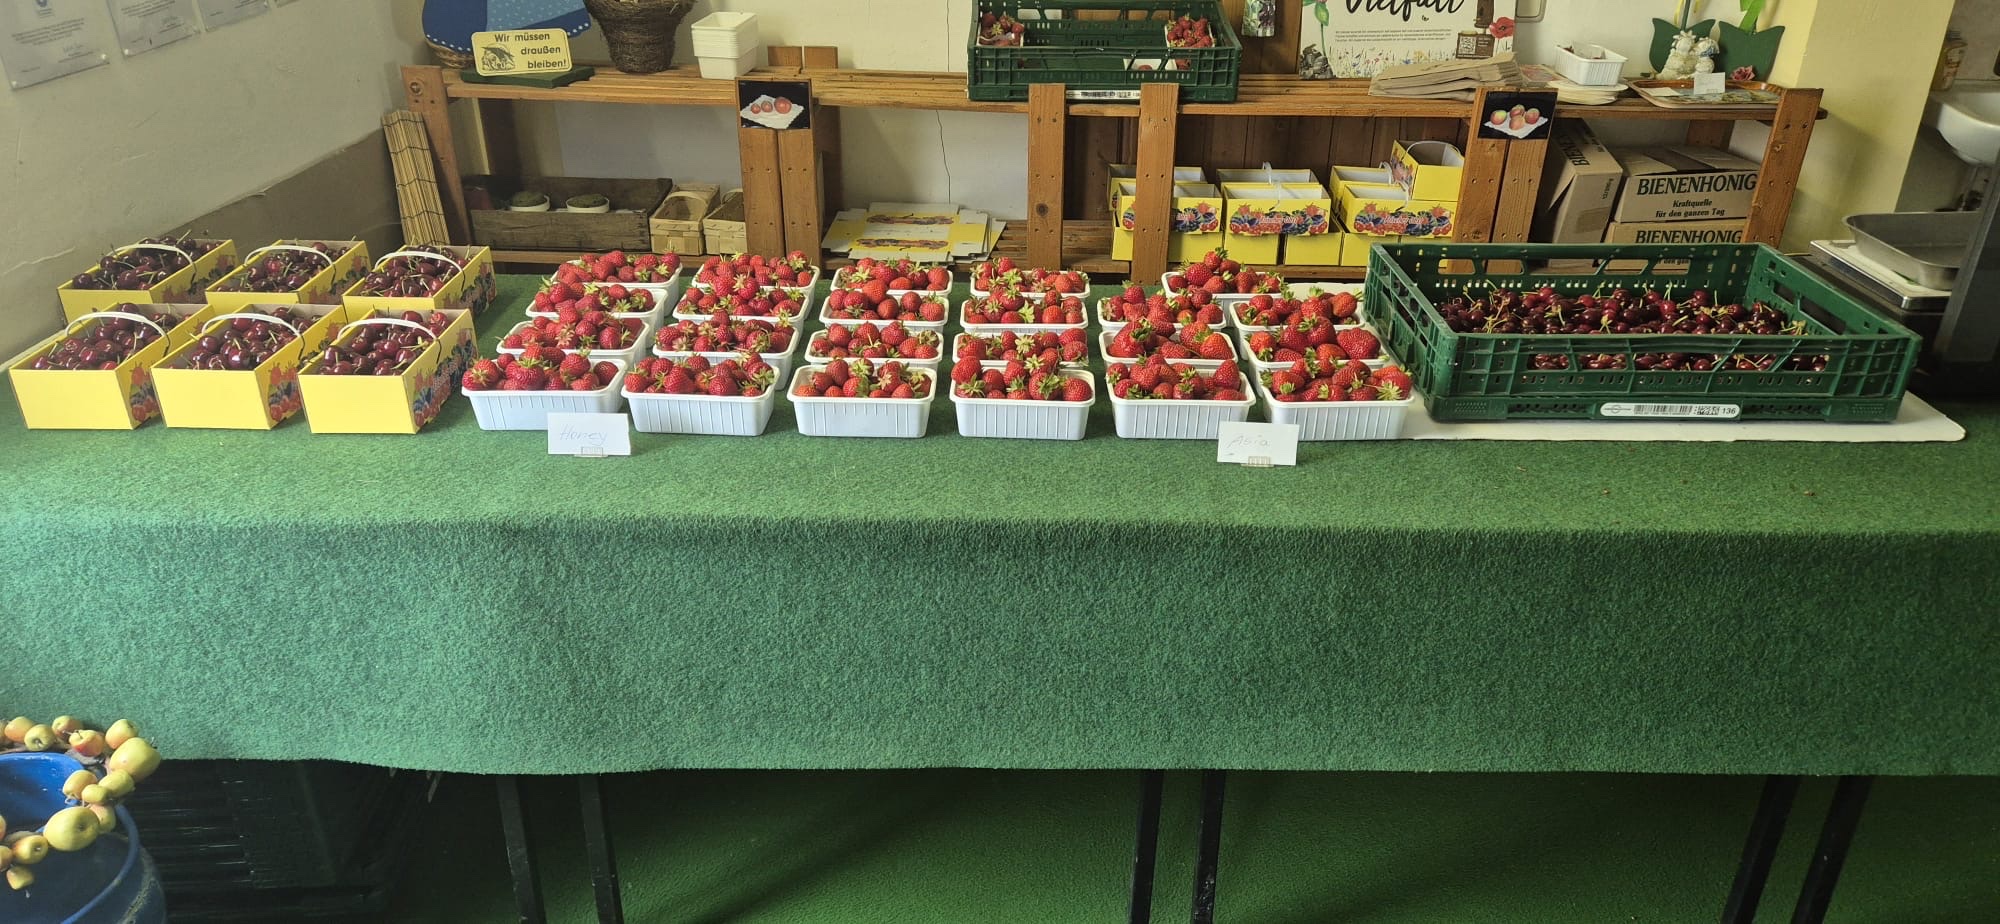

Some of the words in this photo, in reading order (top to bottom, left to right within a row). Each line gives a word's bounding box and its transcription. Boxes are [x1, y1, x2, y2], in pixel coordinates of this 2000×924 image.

[494, 34, 510, 42] Wir
[514, 33, 550, 41] müssen
[520, 46, 561, 55] draußen
[527, 59, 567, 69] bleiben!
[1637, 174, 1757, 195] BIENENHONIG
[1672, 199, 1713, 209] Kraftquelle
[1655, 209, 1666, 218] für
[1668, 209, 1682, 217] den
[1683, 210, 1710, 218] ganzen
[1711, 208, 1725, 217] Tag
[1635, 230, 1743, 243] BIENENHONIG
[1722, 407, 1736, 415] 136
[560, 426, 608, 446] Honey
